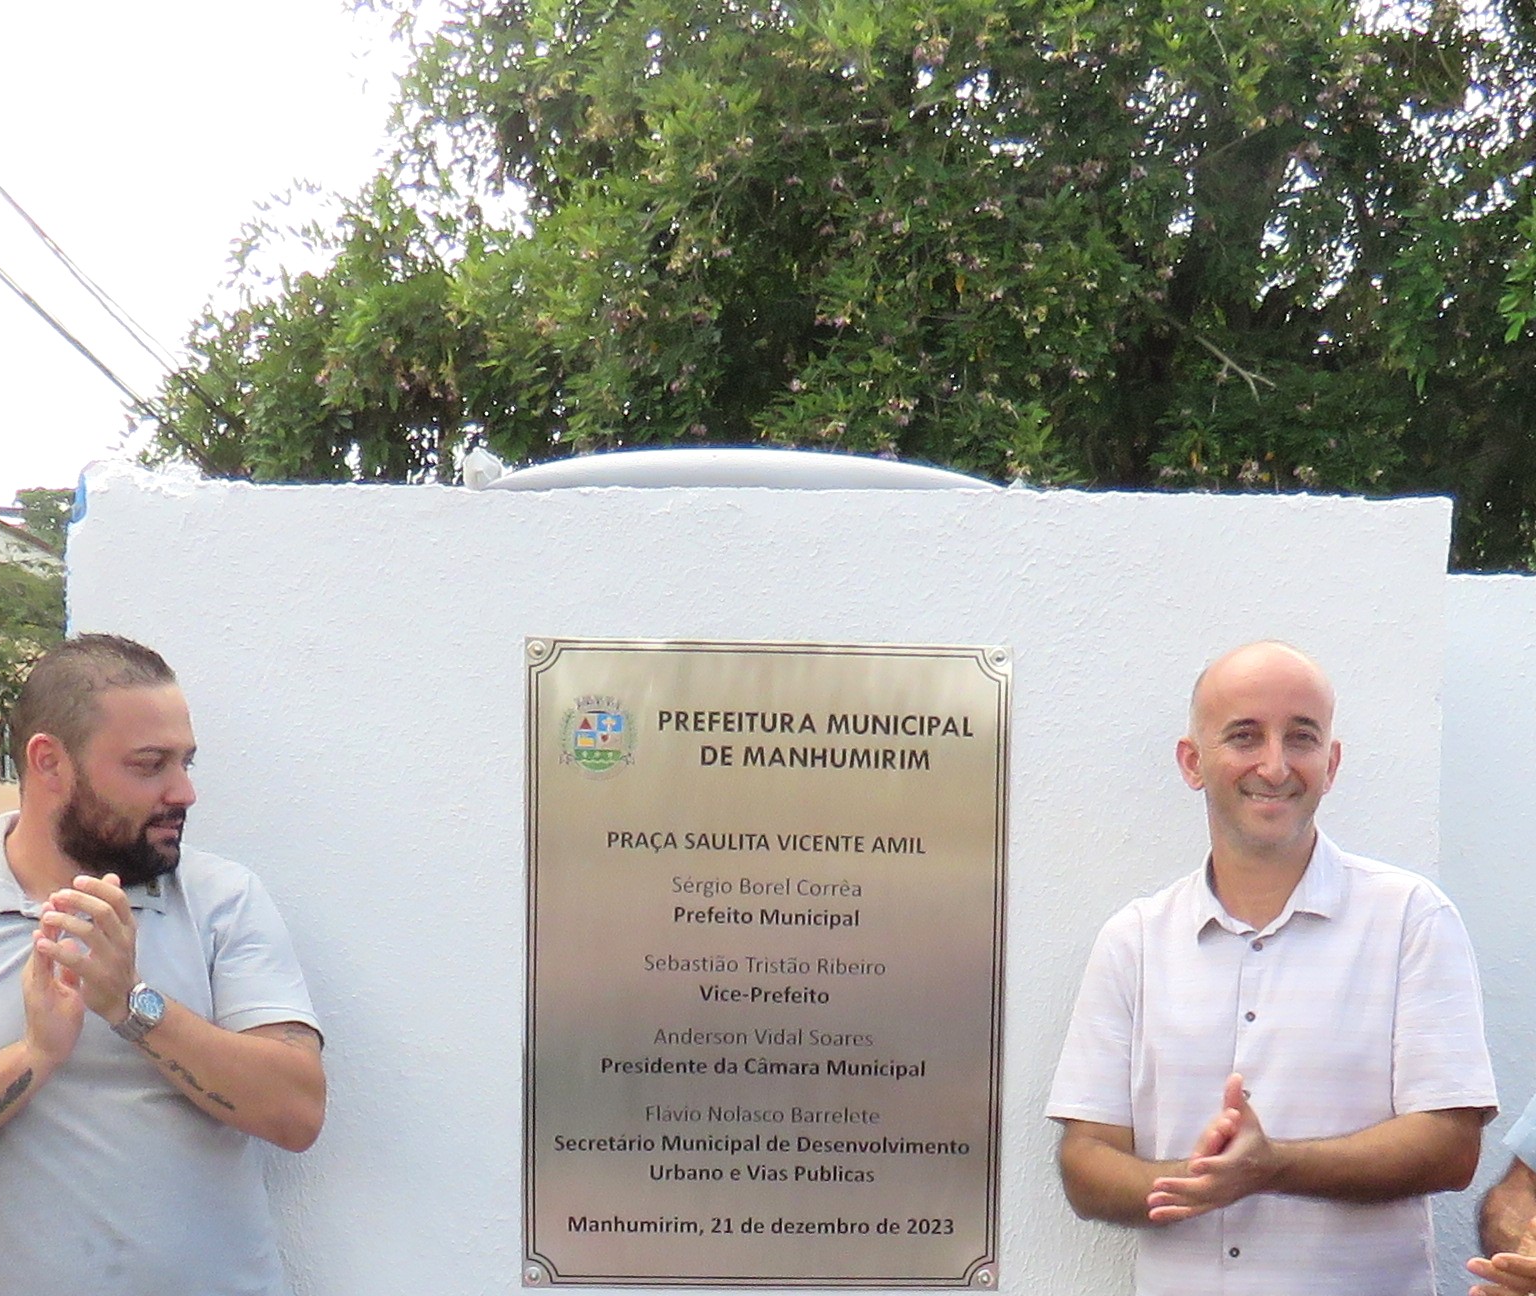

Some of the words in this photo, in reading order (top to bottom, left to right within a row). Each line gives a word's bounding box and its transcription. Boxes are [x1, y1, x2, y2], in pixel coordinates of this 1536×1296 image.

[658, 710, 817, 734] PREFEITURA
[826, 713, 974, 738] MUNICIPAL
[700, 745, 733, 767] DE
[742, 746, 930, 771] MANHUMIRIM
[607, 831, 678, 853] PRAÇA
[684, 832, 770, 851] SAULITA
[777, 834, 865, 853] VICENTE
[871, 836, 926, 855] AMIL
[672, 876, 733, 898] Sérgio
[739, 877, 791, 896] Borel
[796, 878, 862, 897] Corrêa
[674, 906, 753, 925] Prefeito
[760, 908, 860, 930] Municipal
[644, 954, 739, 973] Sebastião
[745, 956, 811, 974] Tristão
[817, 957, 886, 976] Ribeiro
[699, 984, 830, 1004] Vice-Prefeito
[653, 1027, 747, 1045] Anderson
[754, 1028, 803, 1046] Vidal
[809, 1029, 874, 1047] Soares
[601, 1056, 708, 1075] Presidente
[713, 1057, 738, 1075] da
[744, 1057, 820, 1076] Câmara
[826, 1059, 926, 1081] Municipal
[645, 1104, 702, 1122] Flávio
[708, 1105, 785, 1123] Nolasco
[554, 1134, 655, 1152] Secretário
[661, 1134, 760, 1156] Municipal
[766, 1134, 791, 1152] de
[797, 1136, 970, 1155] Desenvolvimento
[650, 1163, 724, 1181] Urbano
[729, 1168, 741, 1181] e
[746, 1164, 789, 1182] Vias
[568, 1215, 704, 1237] Manhumirim,
[711, 1217, 734, 1234] 21
[740, 1216, 765, 1234] de
[771, 1217, 870, 1235] dezembro
[876, 1217, 900, 1235] de
[906, 1218, 954, 1235] 2023
